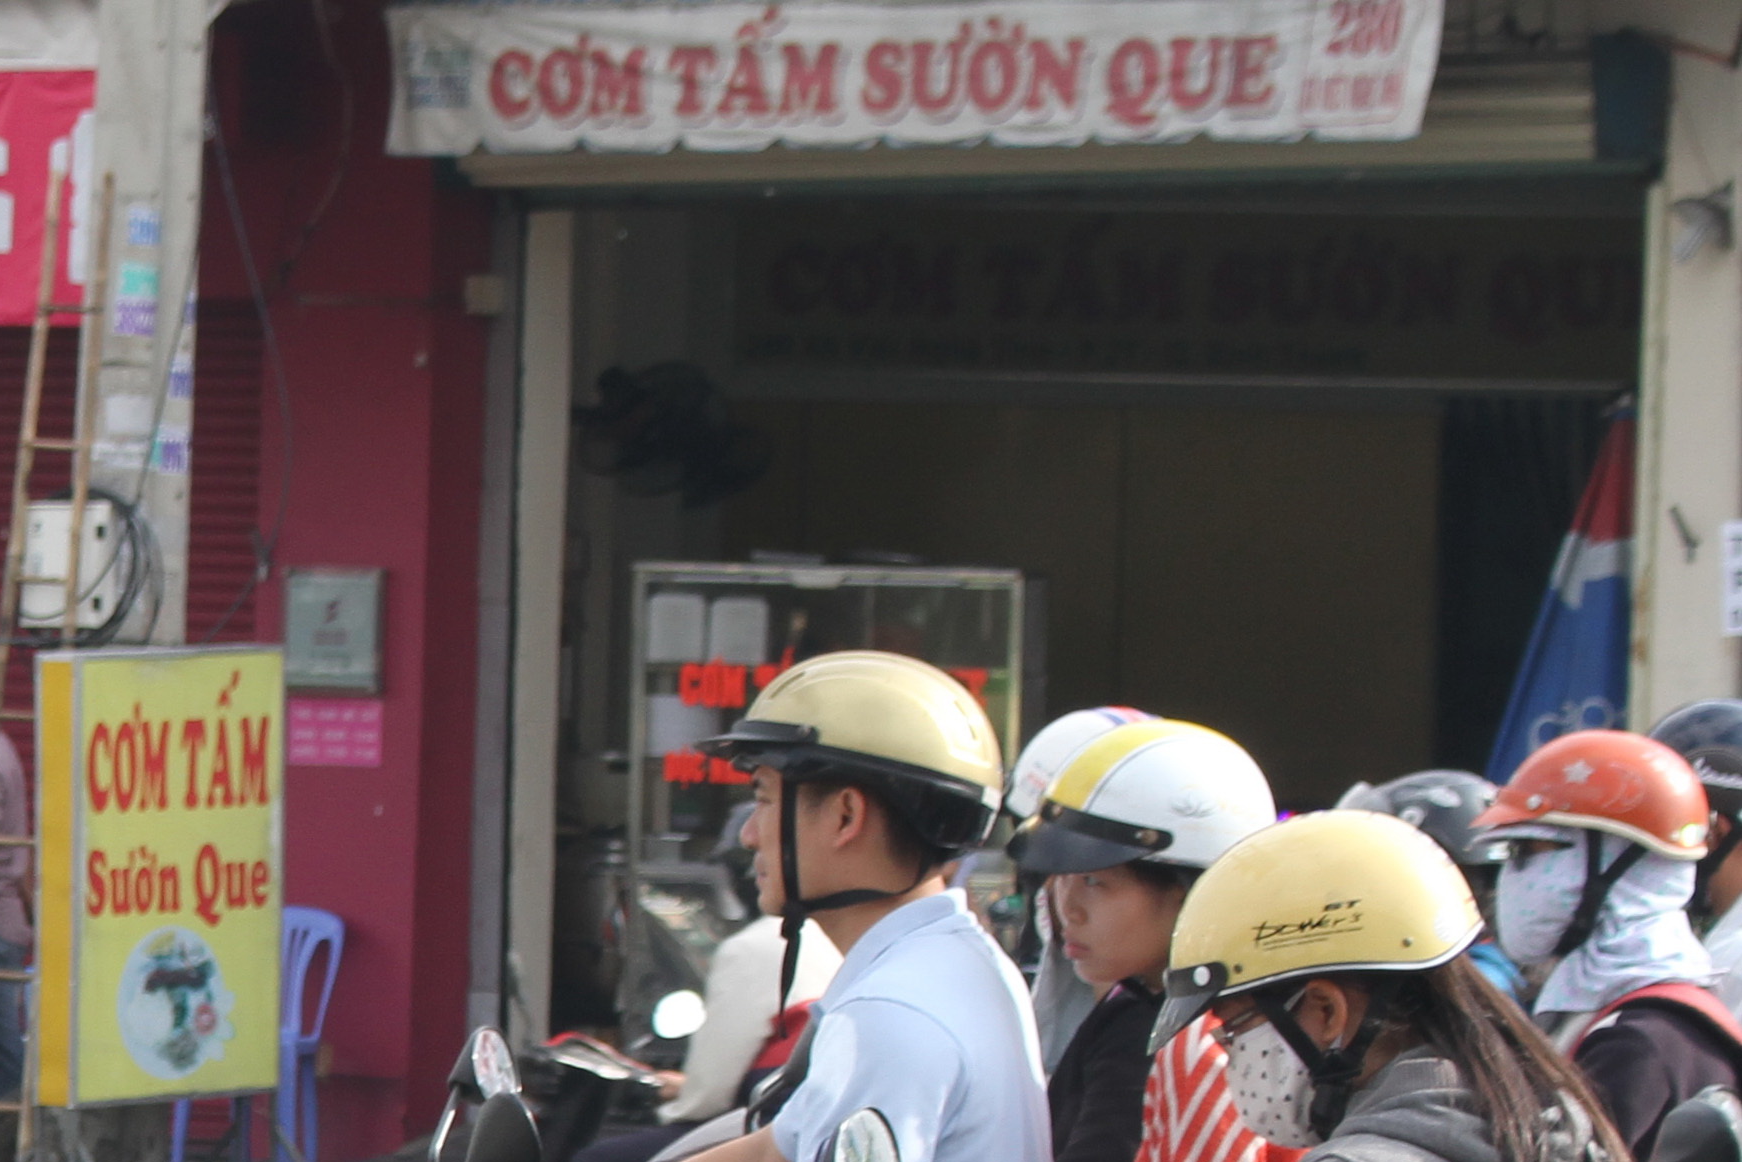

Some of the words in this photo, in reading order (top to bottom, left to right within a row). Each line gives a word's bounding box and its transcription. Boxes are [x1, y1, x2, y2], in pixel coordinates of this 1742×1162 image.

[488, 33, 648, 118] CƠM
[668, 5, 840, 117] TẤM
[862, 17, 1086, 114] SƯỜN
[1106, 35, 1278, 126] QUE
[87, 702, 169, 813] CƠM
[182, 670, 271, 808] TẤM
[86, 845, 181, 917] Sườn
[194, 843, 271, 927] Que
